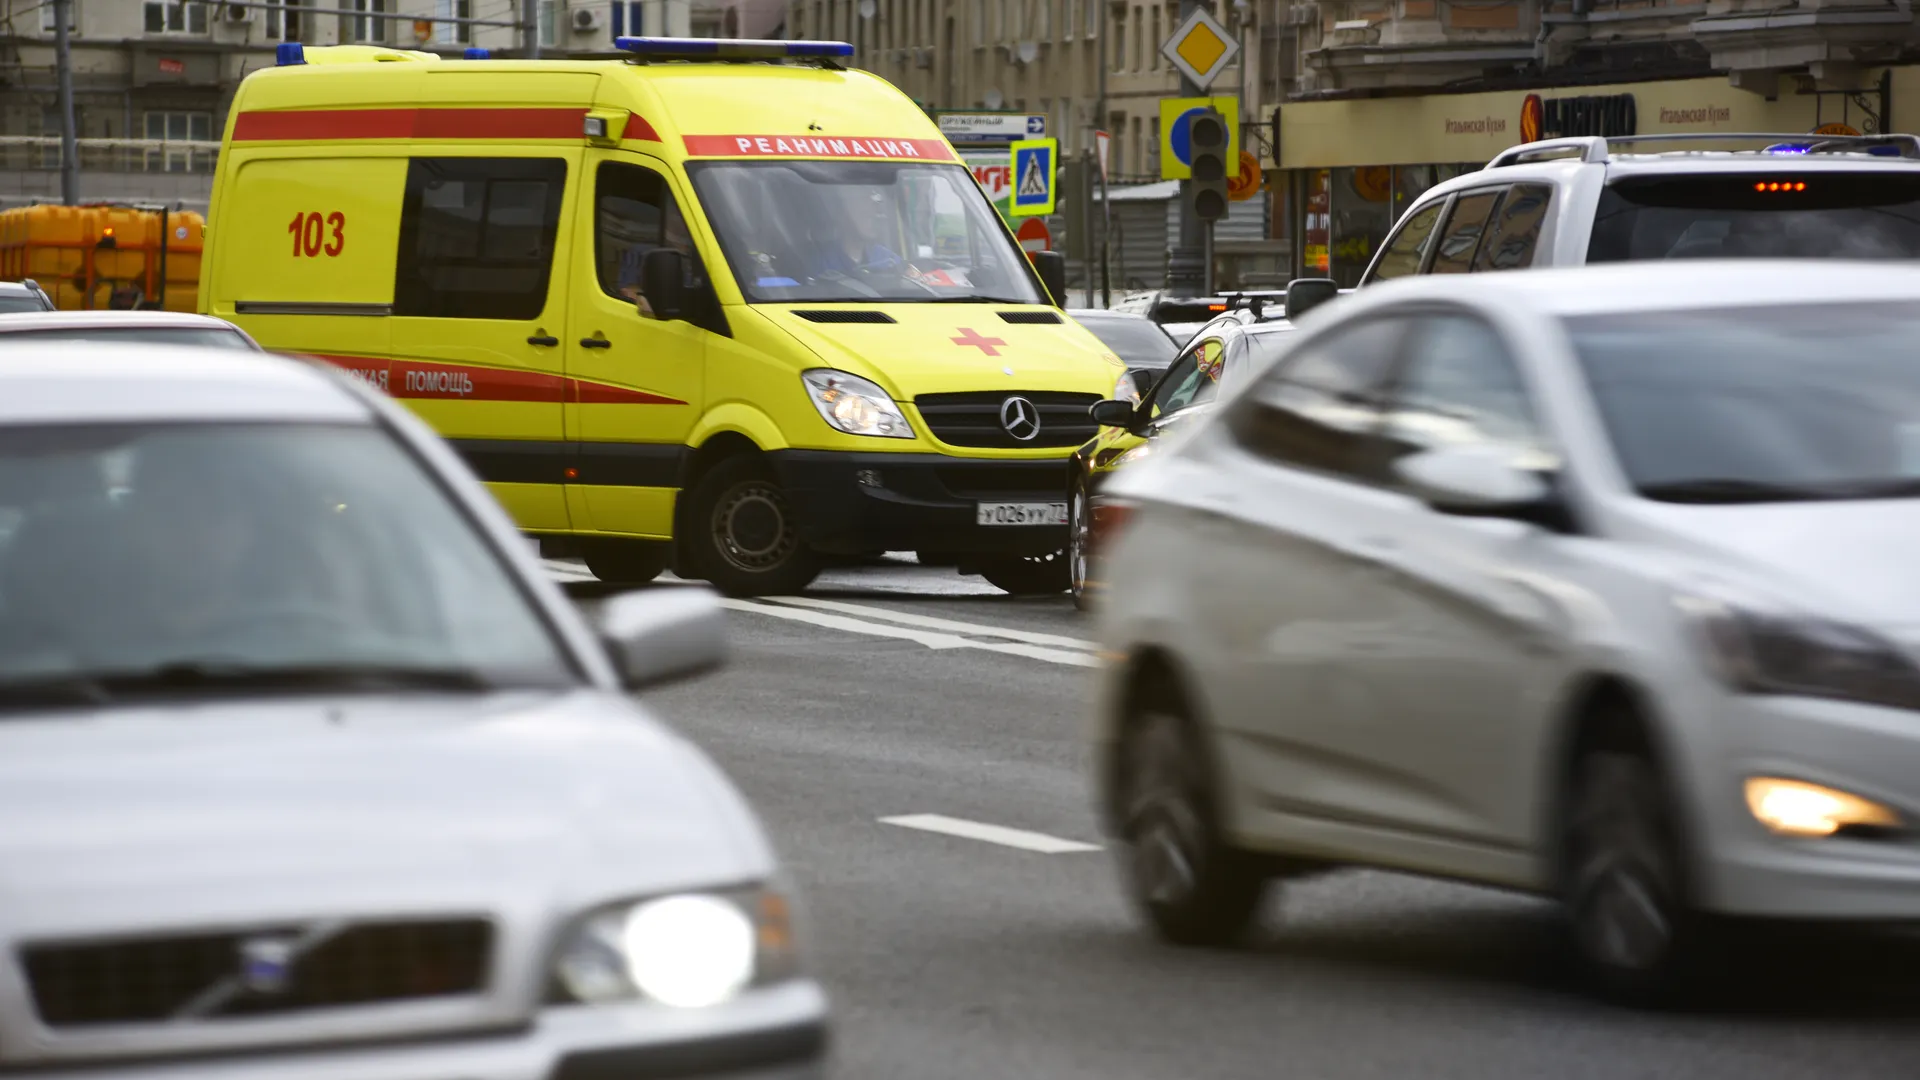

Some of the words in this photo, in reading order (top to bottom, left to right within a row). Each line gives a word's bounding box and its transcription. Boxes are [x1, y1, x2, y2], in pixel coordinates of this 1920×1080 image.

[735, 137, 919, 157] РЕАНИМАЦИЯ
[288, 211, 345, 257] 103
[405, 370, 473, 395] ПОМОЩЬ
